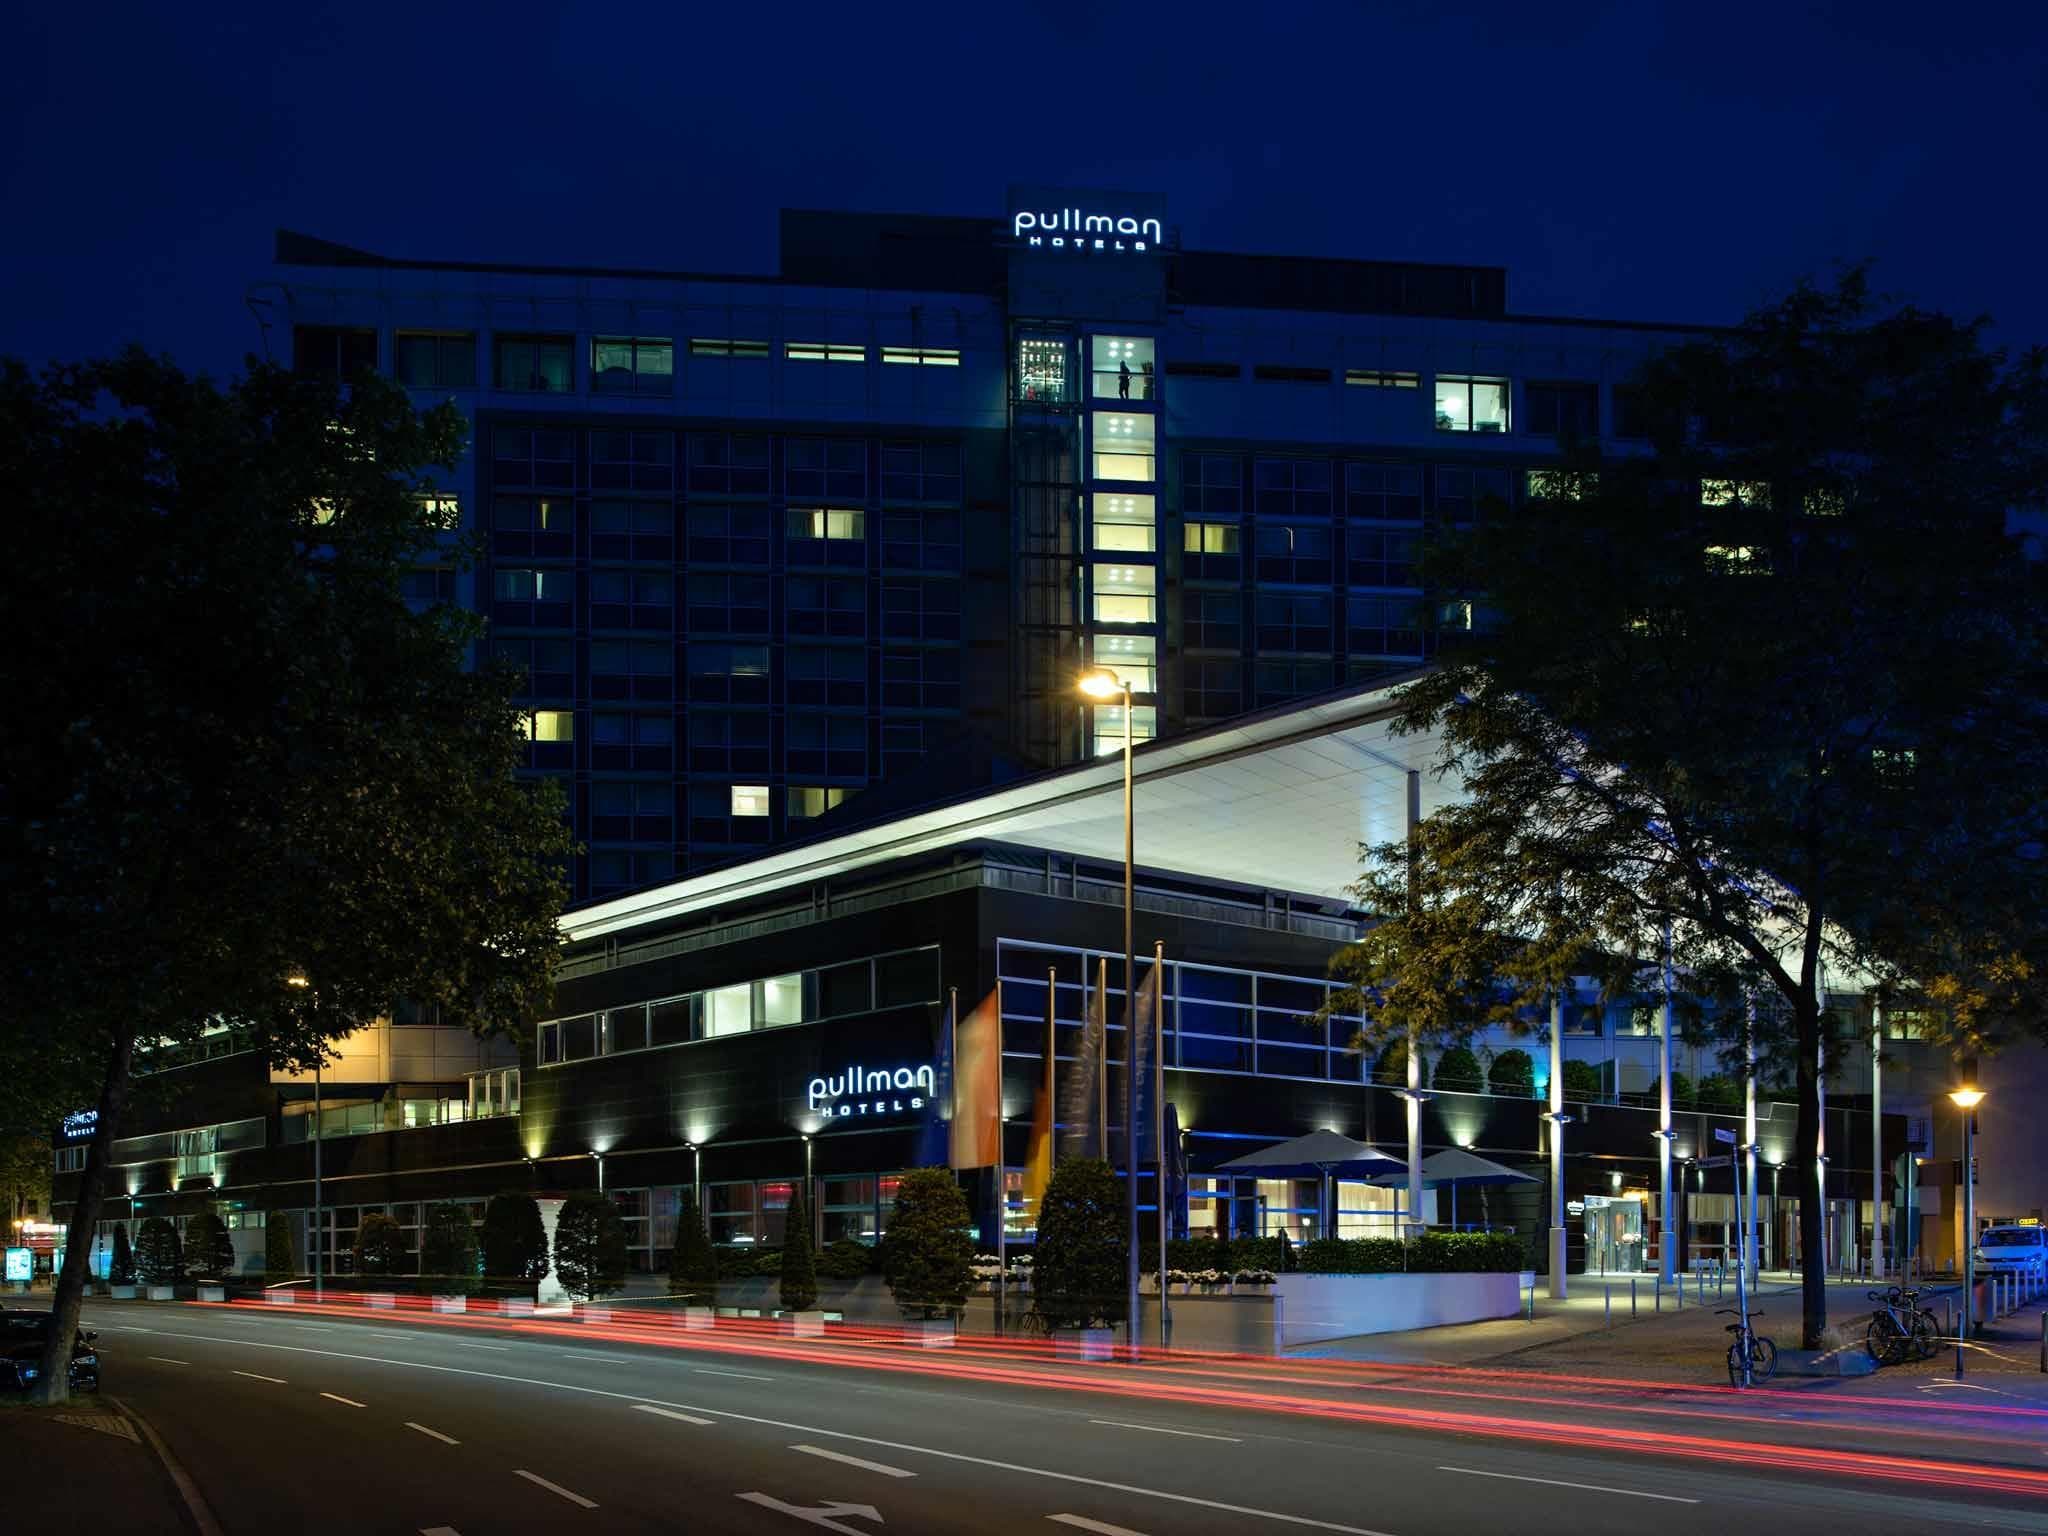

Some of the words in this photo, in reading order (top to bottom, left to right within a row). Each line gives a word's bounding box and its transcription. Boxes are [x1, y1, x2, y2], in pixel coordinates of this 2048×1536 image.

[1015, 208, 1161, 245] pullman
[1029, 236, 1146, 251] HOTELS
[809, 1065, 933, 1111] pullman
[822, 1097, 924, 1118] HOTELS
